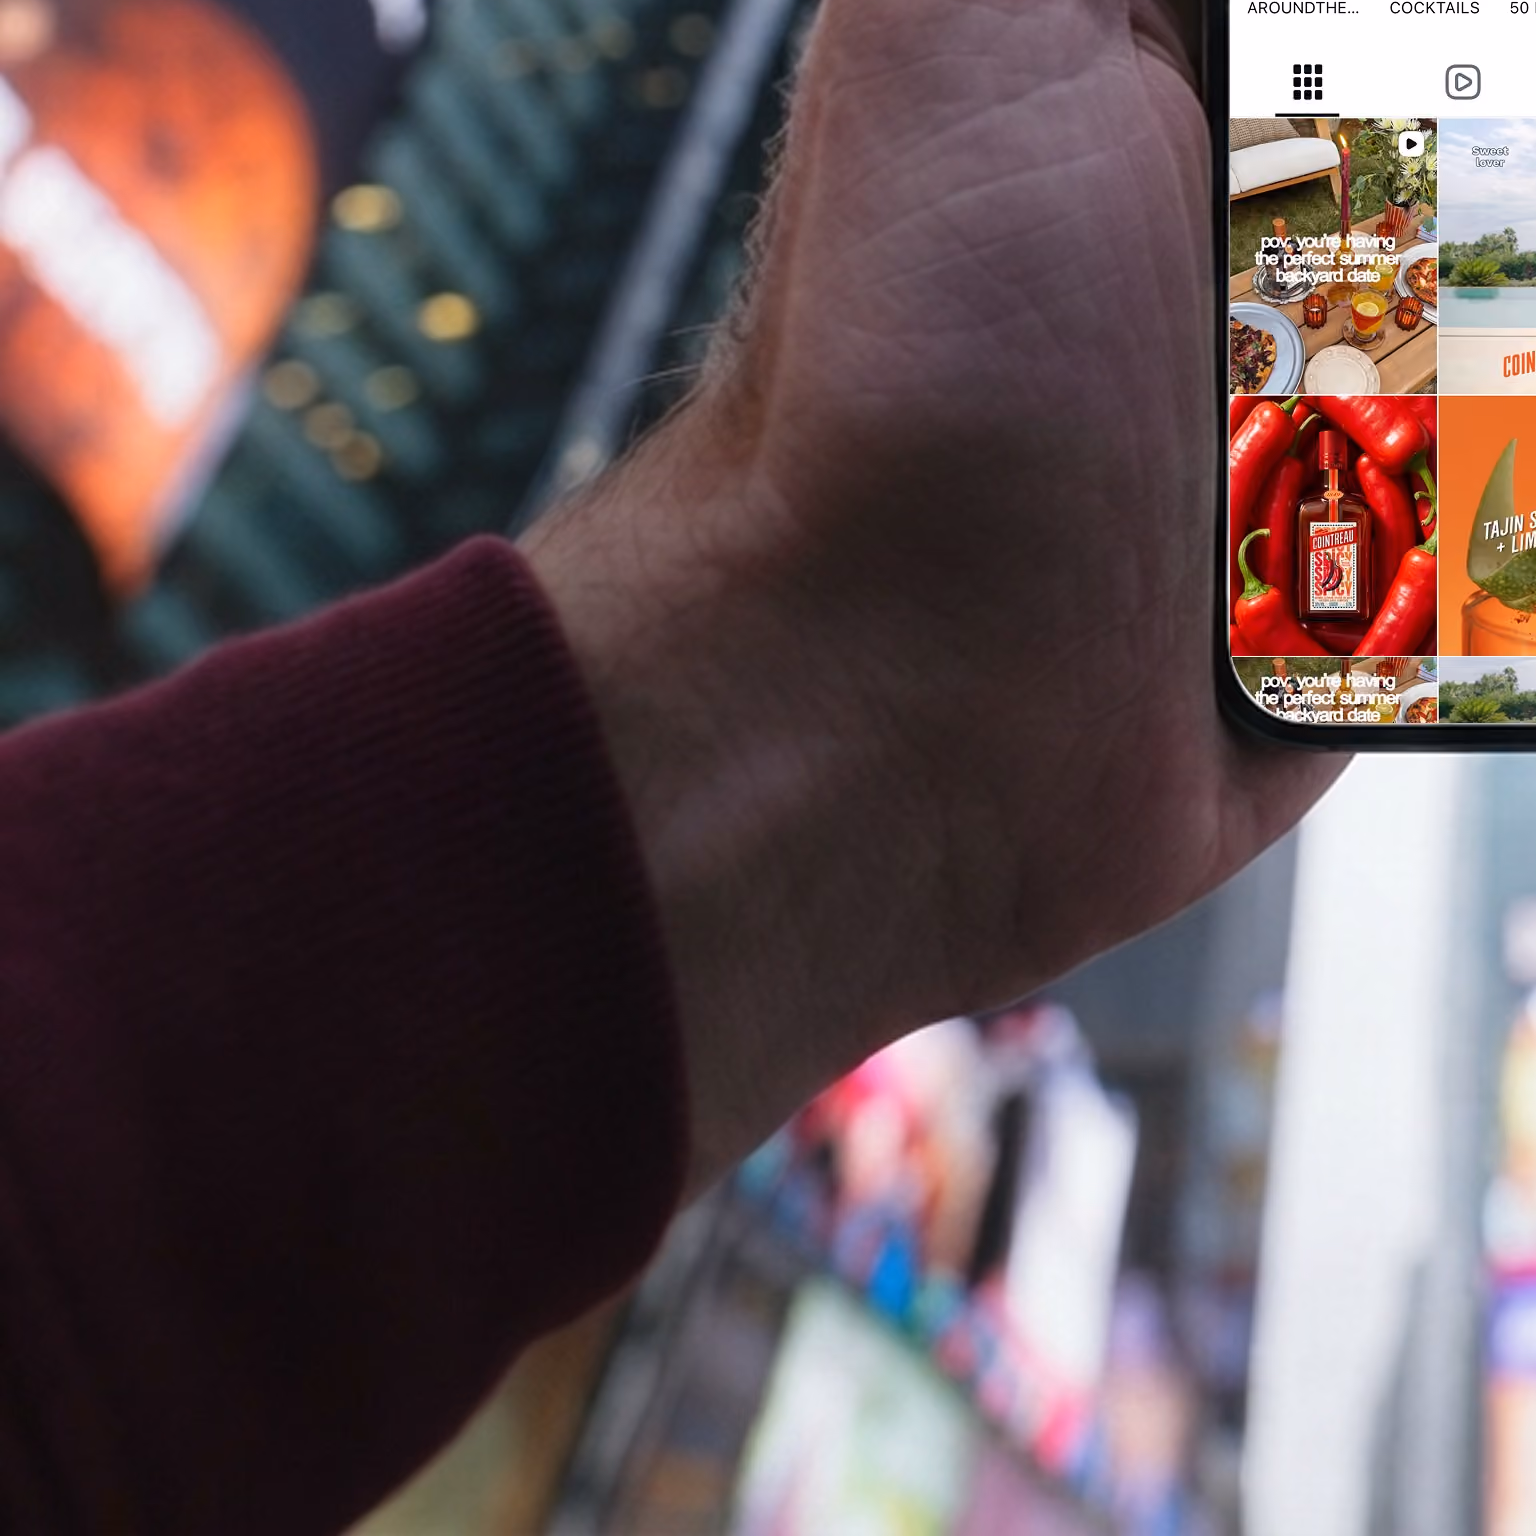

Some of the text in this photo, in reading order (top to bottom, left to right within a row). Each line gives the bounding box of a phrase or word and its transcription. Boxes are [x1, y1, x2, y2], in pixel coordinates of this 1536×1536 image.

[1389, 1, 1480, 15] COCKTAILS
[1510, 1, 1529, 15] 50
[1472, 146, 1509, 156] Sweet
[1476, 157, 1505, 167] lover
[1346, 234, 1396, 250] having
[1255, 251, 1400, 268] the perfect summer
[1276, 268, 1380, 285] backyard date
[1483, 514, 1524, 540] TAJIN
[1312, 529, 1354, 550] COINTREAU
[1346, 673, 1396, 689] having
[1255, 690, 1400, 708] the perfect summer
[1347, 707, 1380, 722] date
